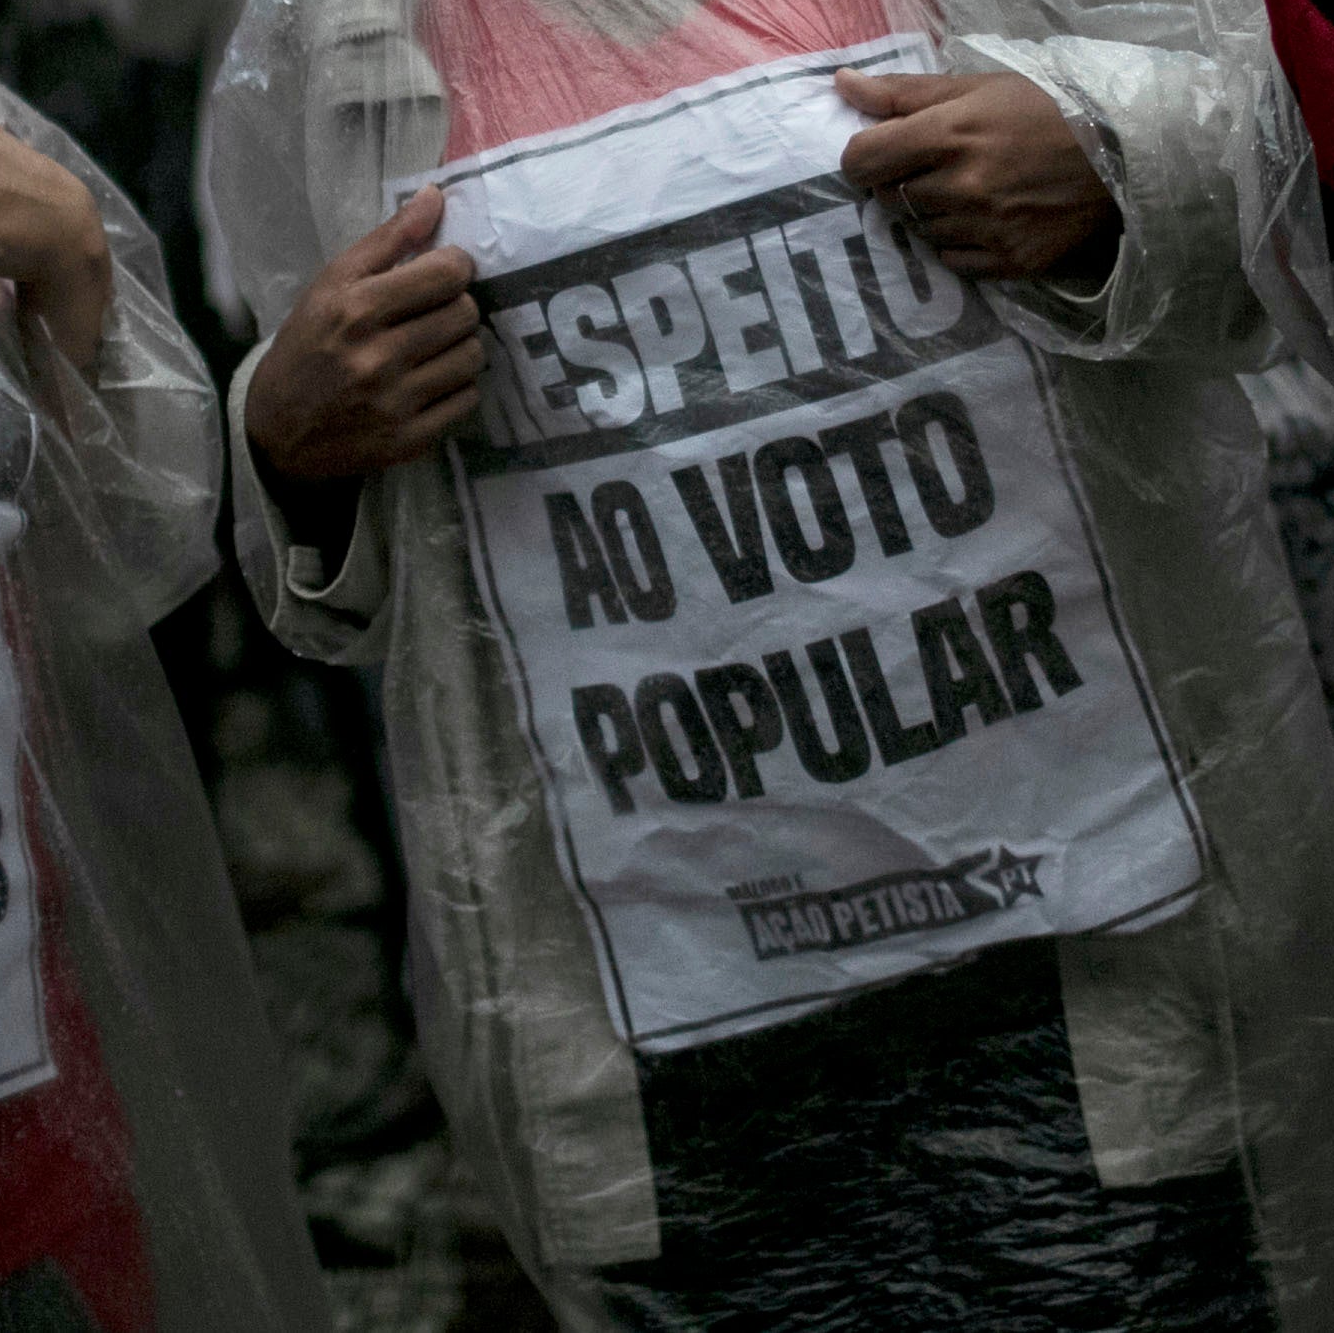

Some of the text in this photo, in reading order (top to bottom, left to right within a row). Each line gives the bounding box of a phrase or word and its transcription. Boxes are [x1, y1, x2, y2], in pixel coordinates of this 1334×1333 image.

[543, 389, 996, 631] AO VOTO
[571, 569, 1083, 816] POPULAR
[749, 865, 1034, 953] AÇÃO PETISTA PT
